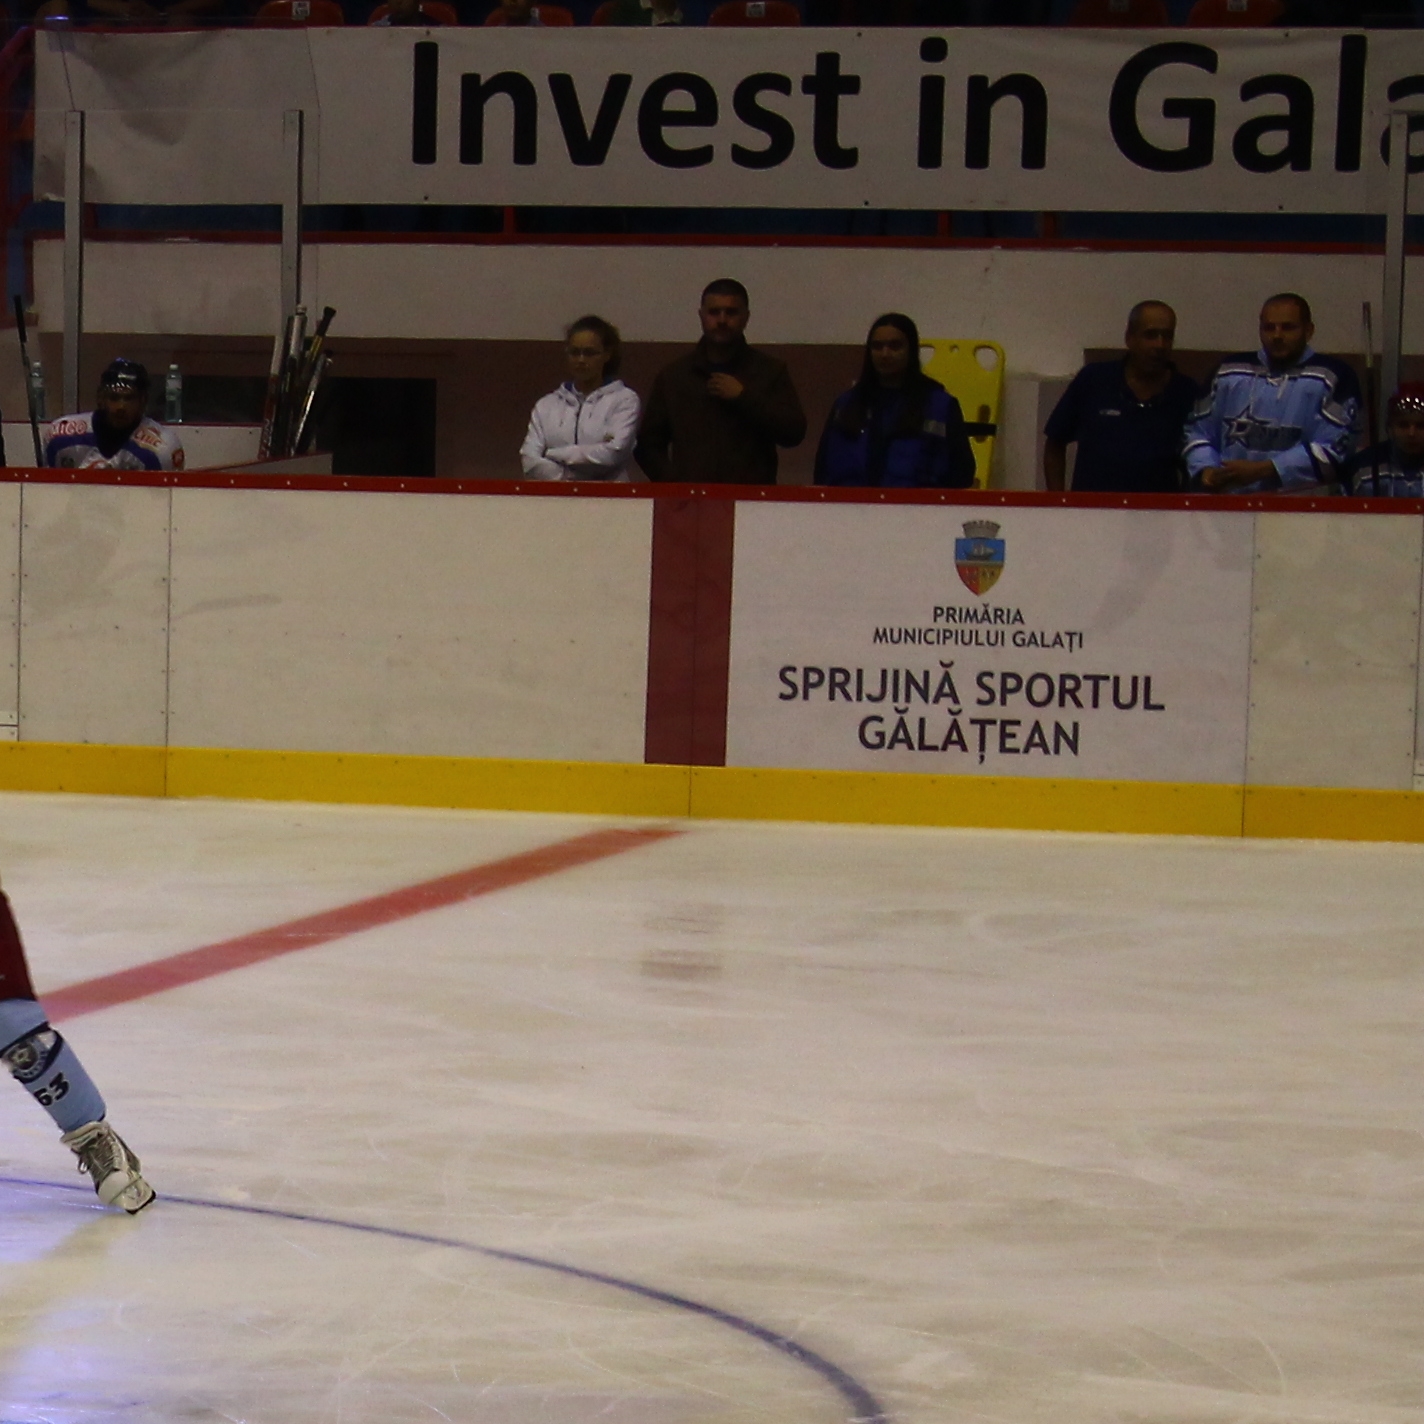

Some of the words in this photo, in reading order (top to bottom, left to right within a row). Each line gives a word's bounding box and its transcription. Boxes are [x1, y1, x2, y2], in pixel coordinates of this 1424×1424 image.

[411, 41, 862, 171] Invest
[917, 36, 1049, 171] in
[932, 603, 1026, 626] PRIMĂRIA
[872, 627, 1006, 647] MUNICIPIULUI
[778, 660, 961, 706] SPRIJINĂ
[975, 671, 1166, 712] SPORTUL
[33, 1072, 70, 1107] 63
